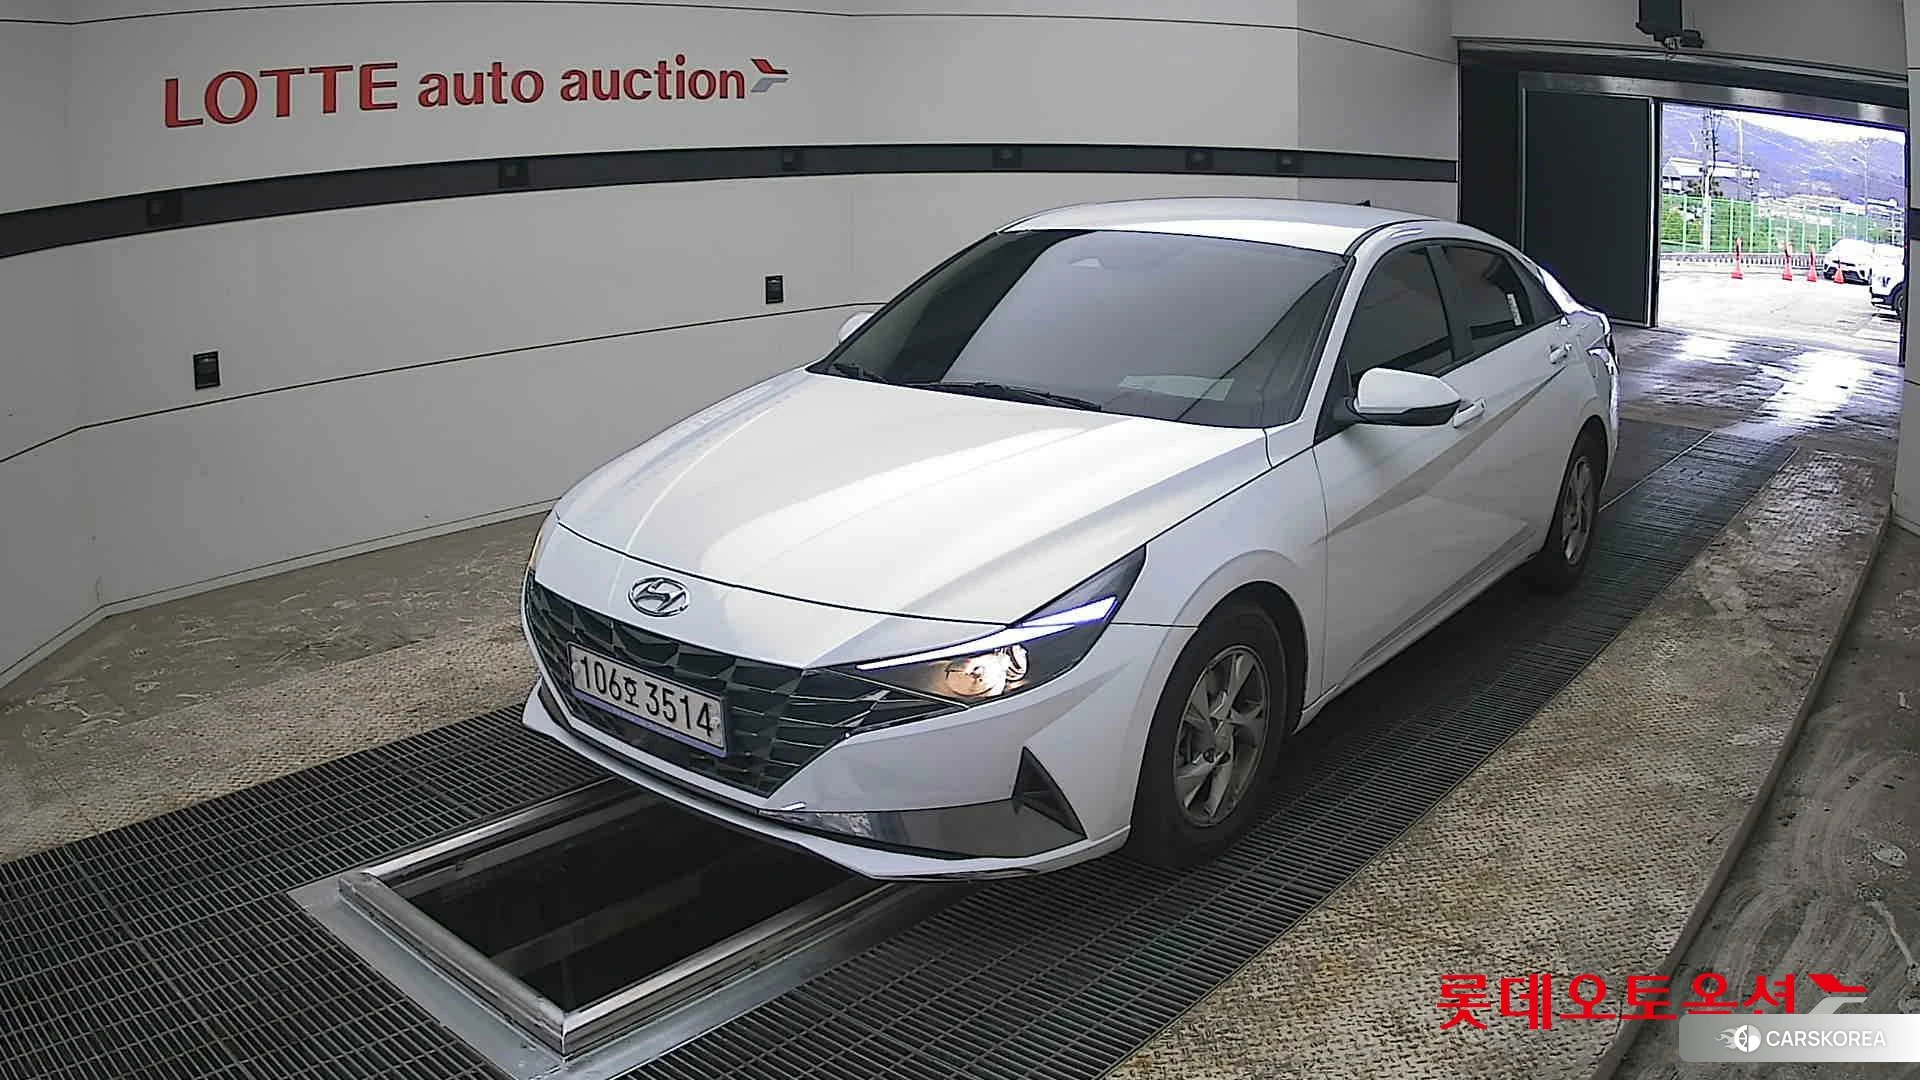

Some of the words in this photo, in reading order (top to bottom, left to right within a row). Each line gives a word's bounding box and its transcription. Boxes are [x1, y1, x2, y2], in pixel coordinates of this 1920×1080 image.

[164, 62, 399, 128] LOTTE
[418, 62, 544, 107] auto
[560, 54, 746, 102] auction
[644, 681, 714, 737] 3514
